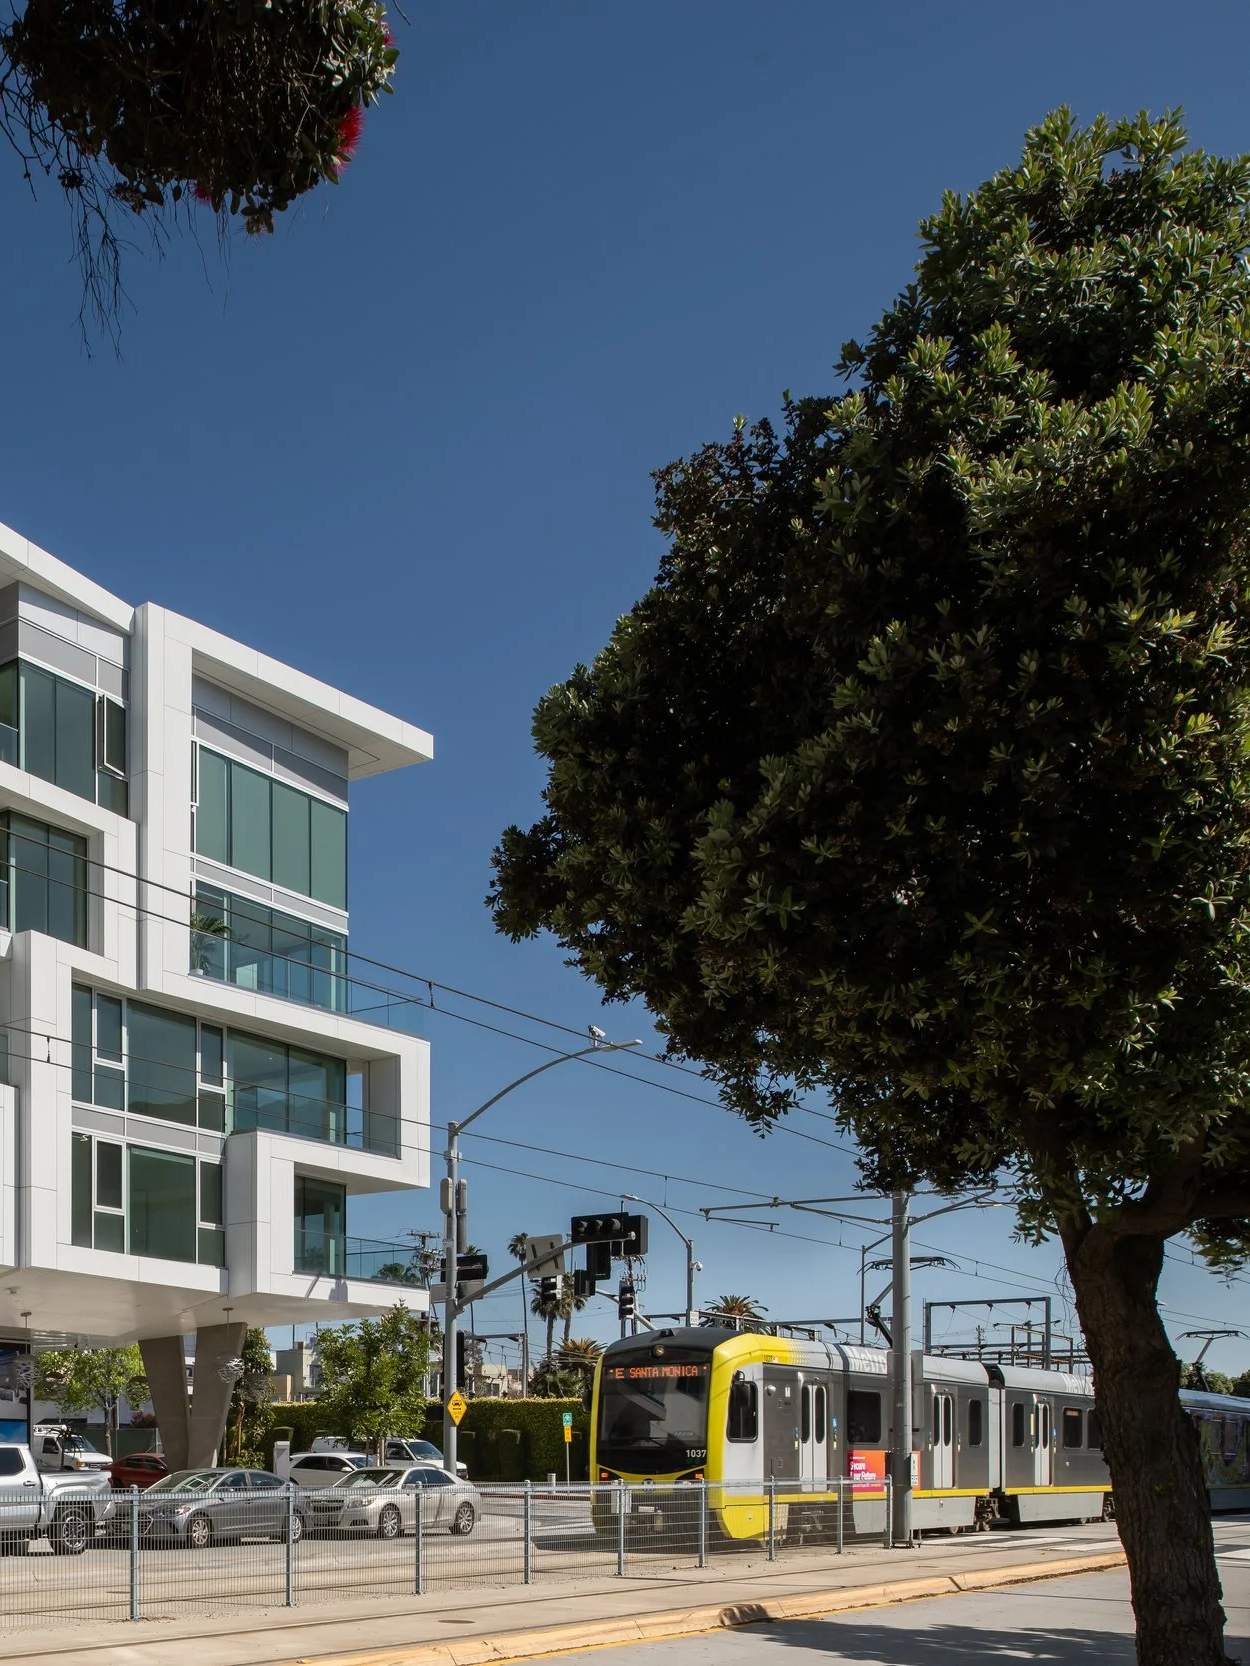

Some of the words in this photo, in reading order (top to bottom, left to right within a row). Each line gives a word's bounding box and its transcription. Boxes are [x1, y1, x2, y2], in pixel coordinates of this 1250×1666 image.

[615, 1367, 625, 1379] E
[629, 1367, 659, 1378] SANTA
[661, 1365, 698, 1378] MONICA
[685, 1449, 707, 1458] 1037
